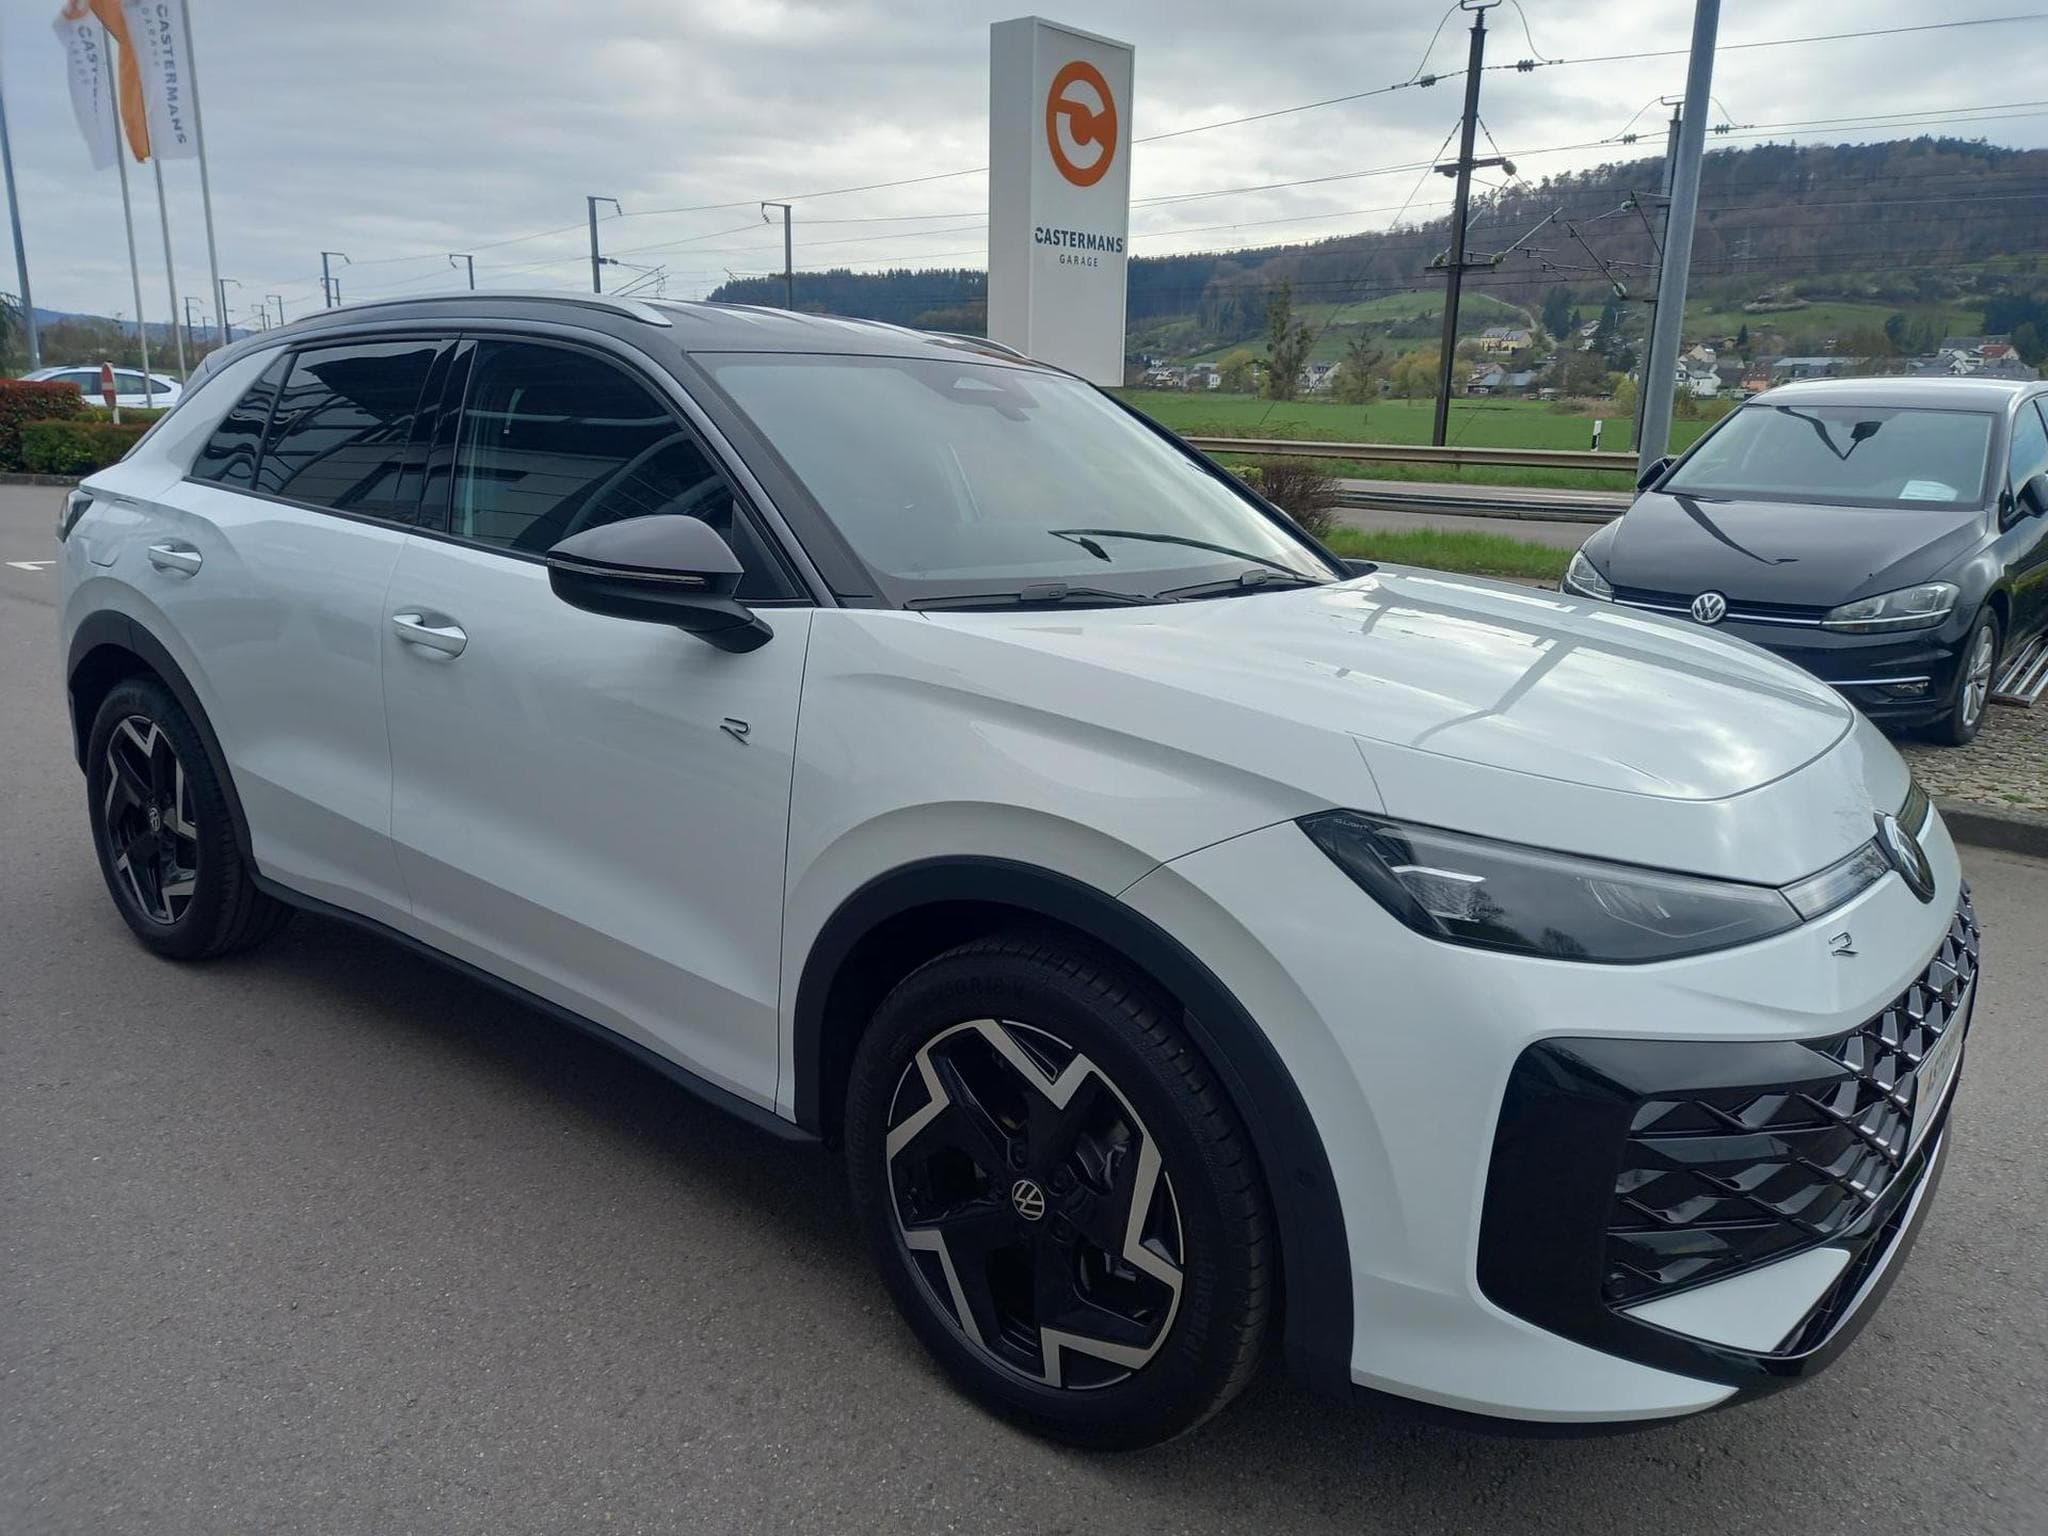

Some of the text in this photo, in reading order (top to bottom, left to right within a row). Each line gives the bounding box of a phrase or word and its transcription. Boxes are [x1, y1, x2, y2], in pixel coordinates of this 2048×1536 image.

[155, 3, 188, 144] CASTERMANS
[1035, 226, 1123, 253] CASTERMANS
[1059, 253, 1099, 268] GARAGE
